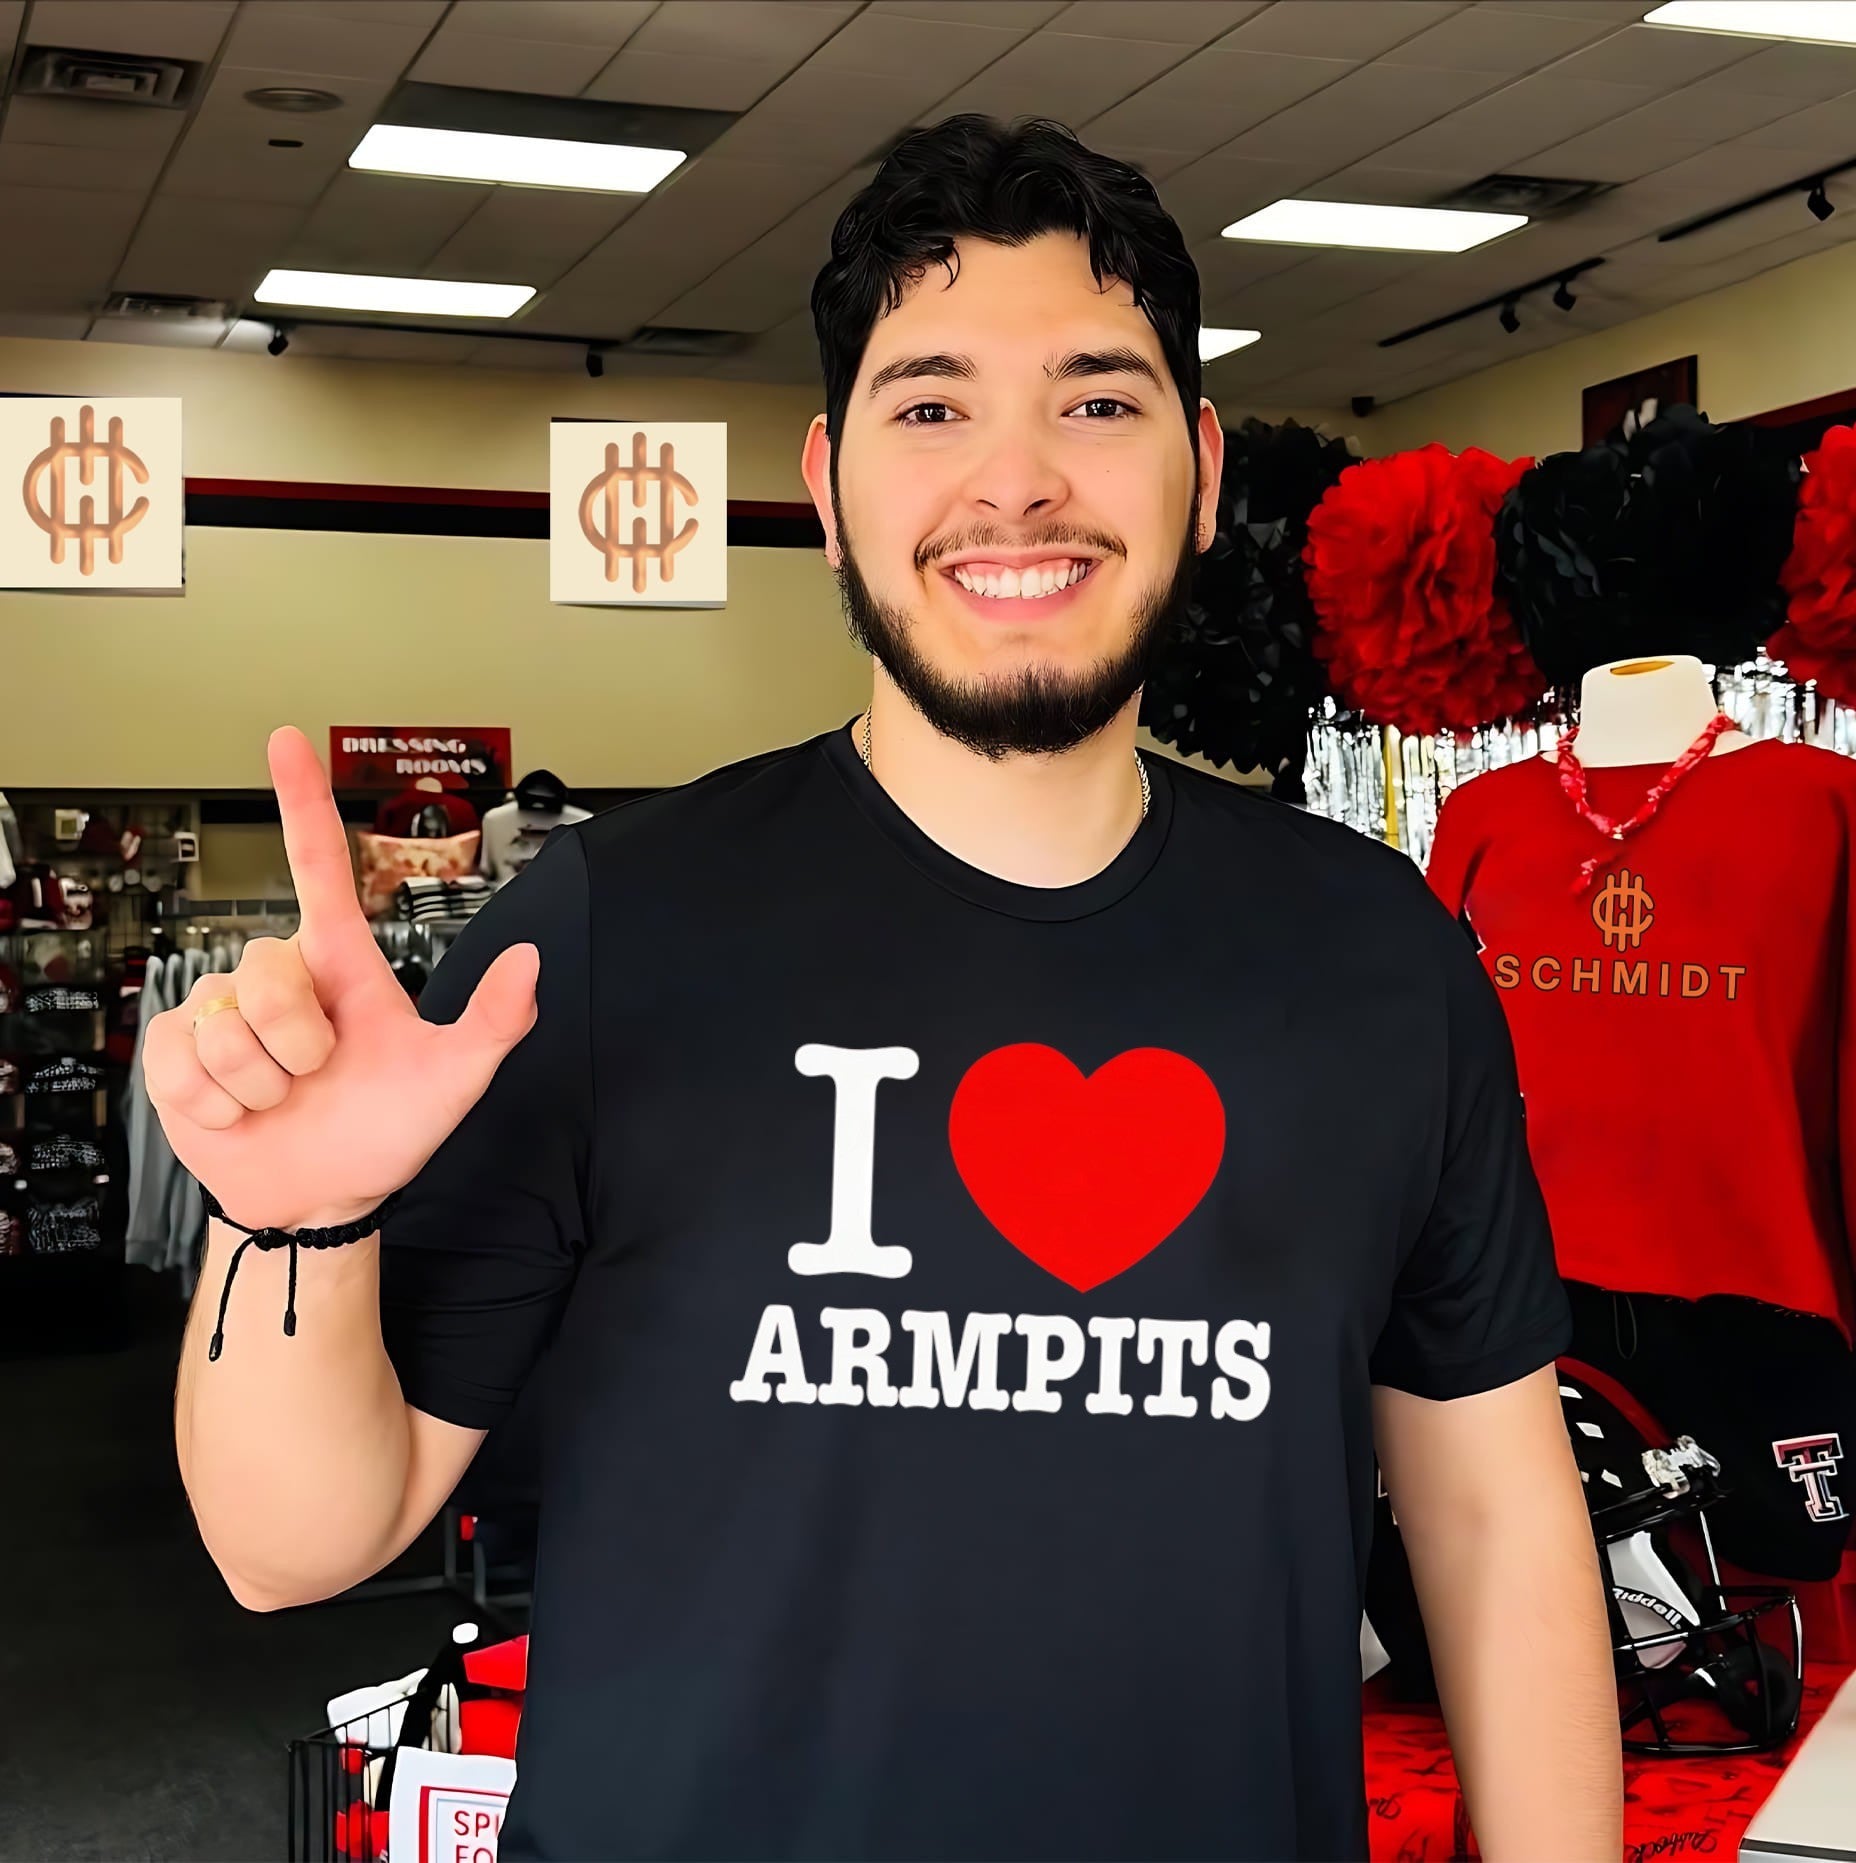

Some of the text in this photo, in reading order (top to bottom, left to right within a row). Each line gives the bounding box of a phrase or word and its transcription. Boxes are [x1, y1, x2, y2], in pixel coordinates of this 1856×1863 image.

[342, 737, 467, 754] DRESSING
[396, 758, 487, 774] ROOMS
[1493, 953, 1747, 1000] SCHMIDT
[788, 1043, 919, 1278] I
[729, 1304, 1271, 1421] ARMPITS
